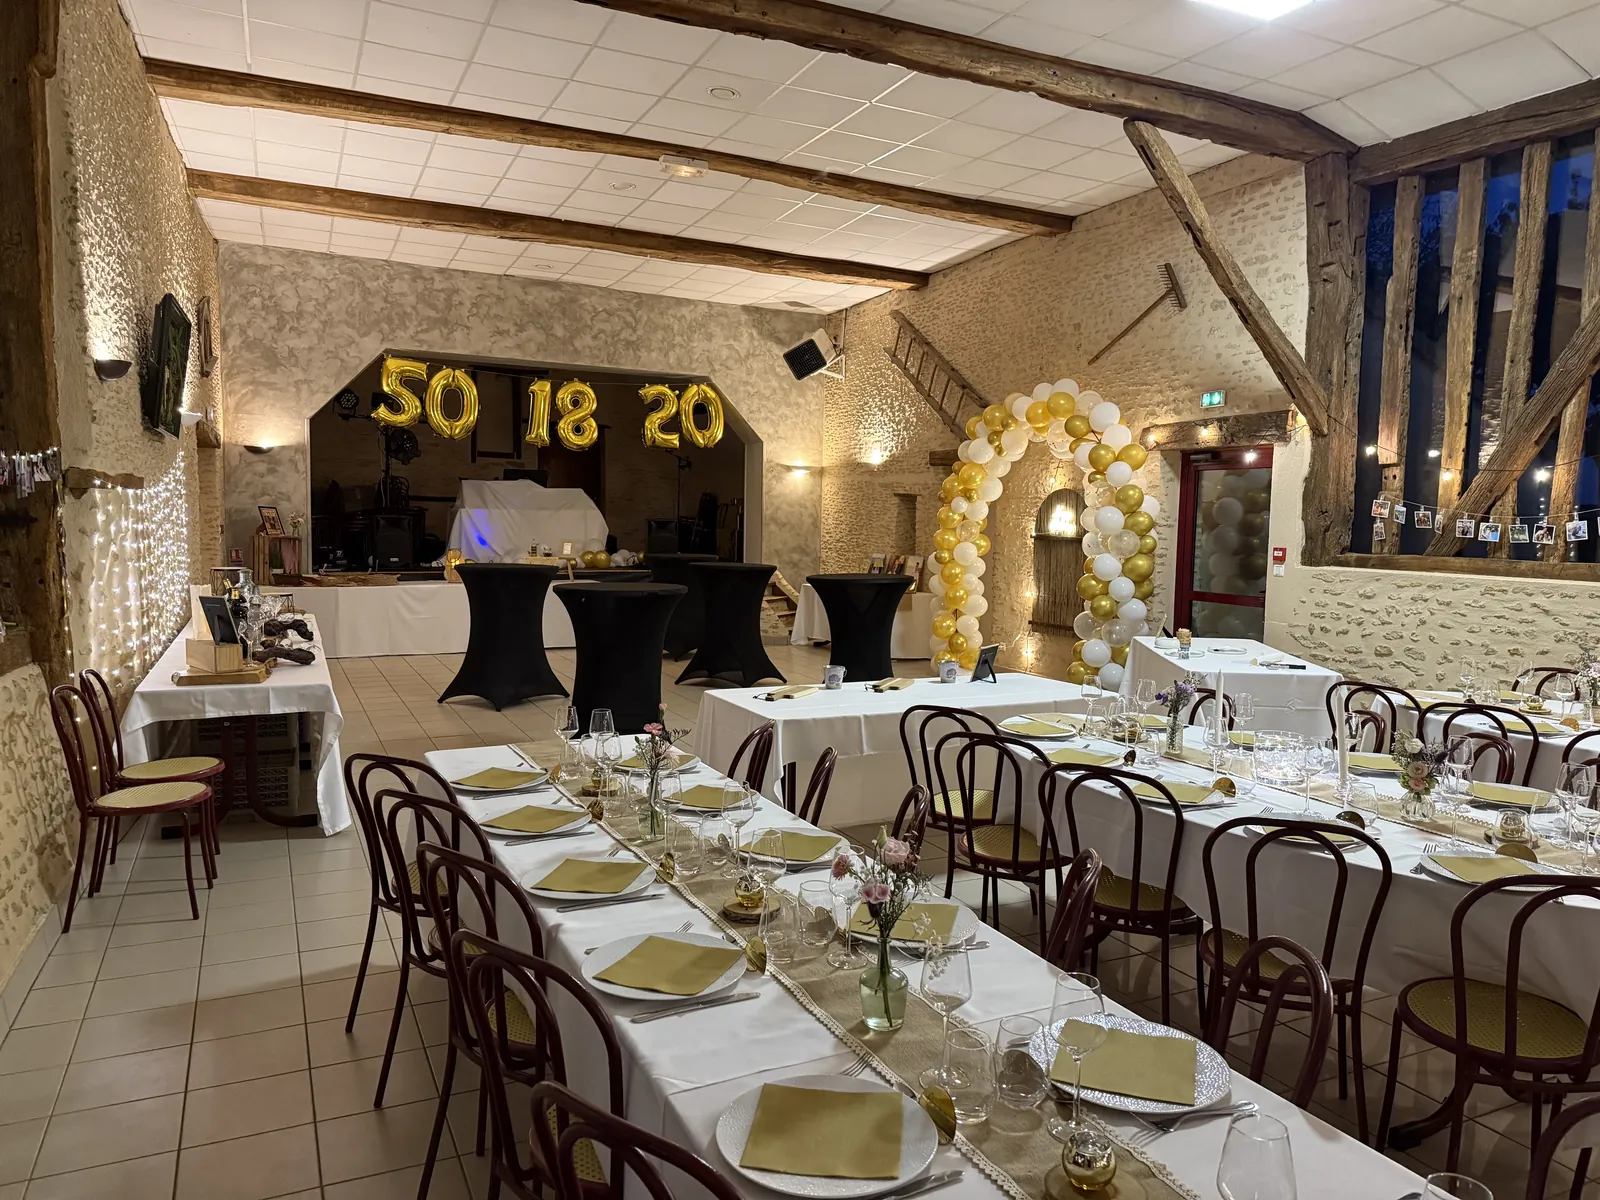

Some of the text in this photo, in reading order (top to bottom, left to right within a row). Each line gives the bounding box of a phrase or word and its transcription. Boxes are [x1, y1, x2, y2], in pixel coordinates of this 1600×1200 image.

[371, 354, 724, 450] 50 18 20
